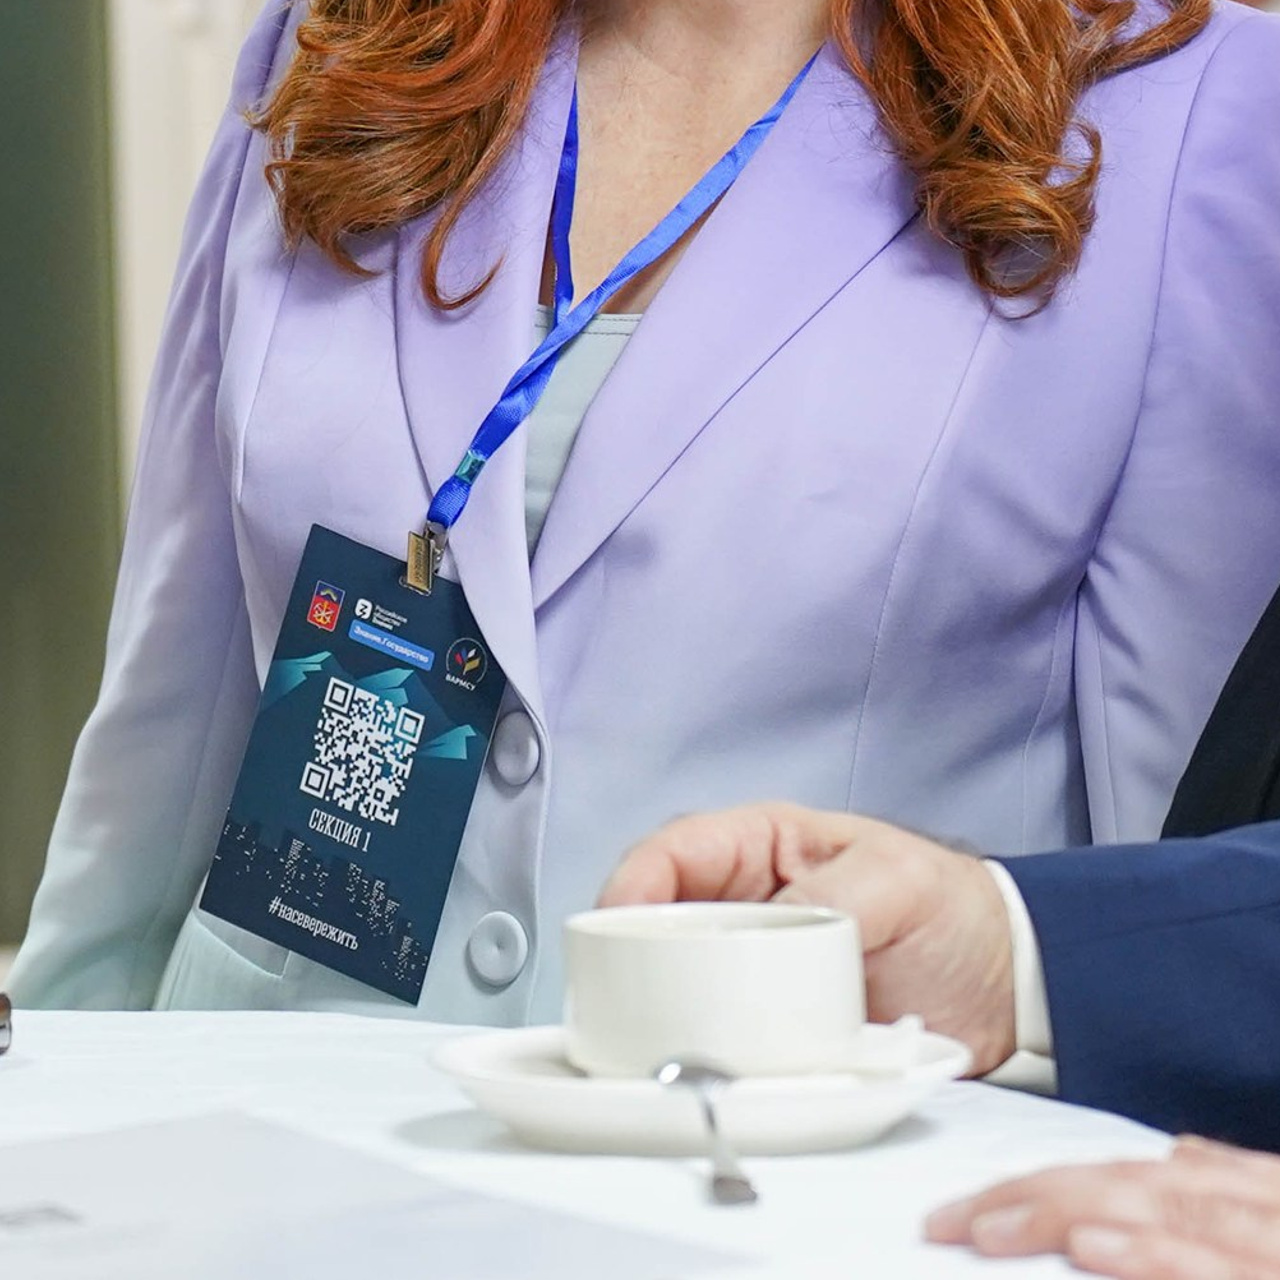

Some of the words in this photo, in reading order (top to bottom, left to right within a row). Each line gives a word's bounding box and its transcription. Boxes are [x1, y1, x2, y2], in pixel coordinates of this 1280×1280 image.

[308, 807, 363, 848] СЕКЦИЯ
[361, 831, 371, 853] 1
[268, 895, 359, 951] #насевережить
